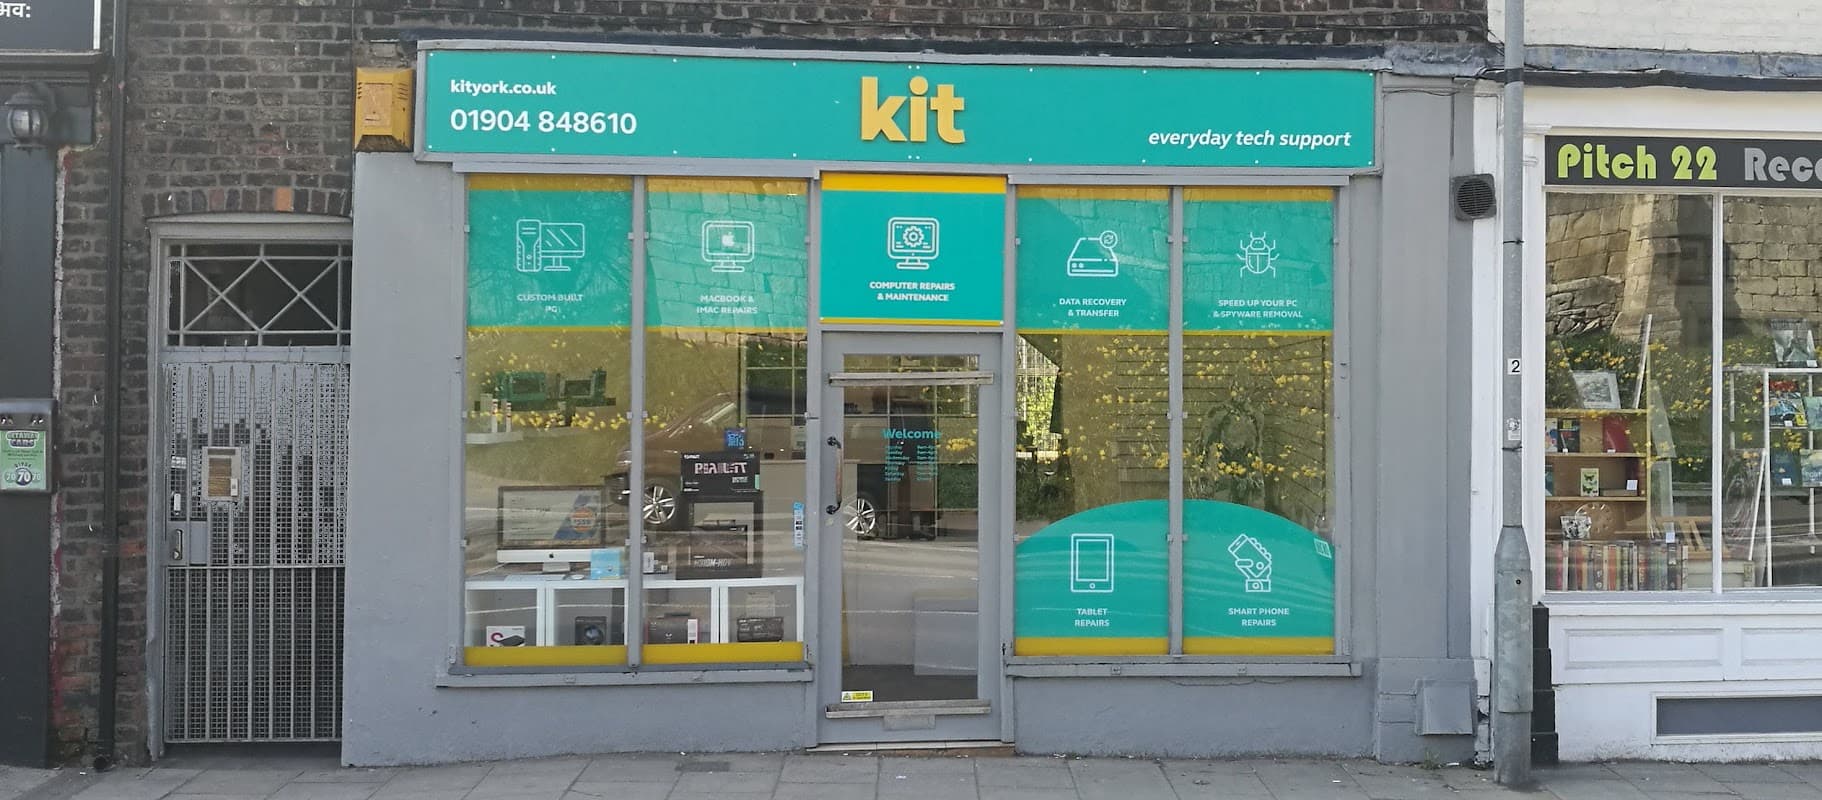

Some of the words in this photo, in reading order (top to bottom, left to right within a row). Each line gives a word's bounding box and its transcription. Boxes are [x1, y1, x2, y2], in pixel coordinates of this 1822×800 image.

[450, 79, 557, 97] kityork.co.uk
[861, 75, 967, 145] kit
[450, 108, 531, 132] 01904
[537, 110, 638, 135] 848610
[1148, 128, 1233, 150] everyday
[1235, 129, 1275, 147] tech
[1279, 131, 1353, 150] support
[1557, 142, 1657, 180] Pitch
[1671, 145, 1718, 181] 22
[869, 281, 918, 290] COMPUTER
[919, 282, 956, 291] REPAIRS
[516, 293, 556, 302] CUSTOM
[557, 294, 584, 303] BUILT
[700, 294, 746, 303] MACBOOK
[877, 292, 884, 301] &
[885, 292, 949, 302] MAINTENANCE
[1059, 297, 1081, 306] DATA
[1082, 298, 1127, 307] RECOVERY
[1218, 299, 1246, 307] SPEED
[1247, 299, 1260, 307] UP
[1260, 299, 1285, 308] YOUR
[1286, 300, 1298, 308] PC
[720, 306, 759, 315] REPAIRS
[1067, 309, 1074, 317] &
[1075, 309, 1120, 318] TRANSFER
[1212, 310, 1220, 319] &
[1220, 310, 1262, 318] SPYWARE
[1262, 310, 1304, 319] REMOVAL
[1511, 359, 1521, 373] 2
[882, 427, 943, 440] Welcome
[18, 471, 31, 482] 70
[1076, 607, 1108, 616] TABLET
[1228, 607, 1258, 616] SMART
[1258, 607, 1290, 616] PHONE
[1074, 619, 1110, 627] REPAIRS
[1241, 618, 1277, 627] REPAIRS
